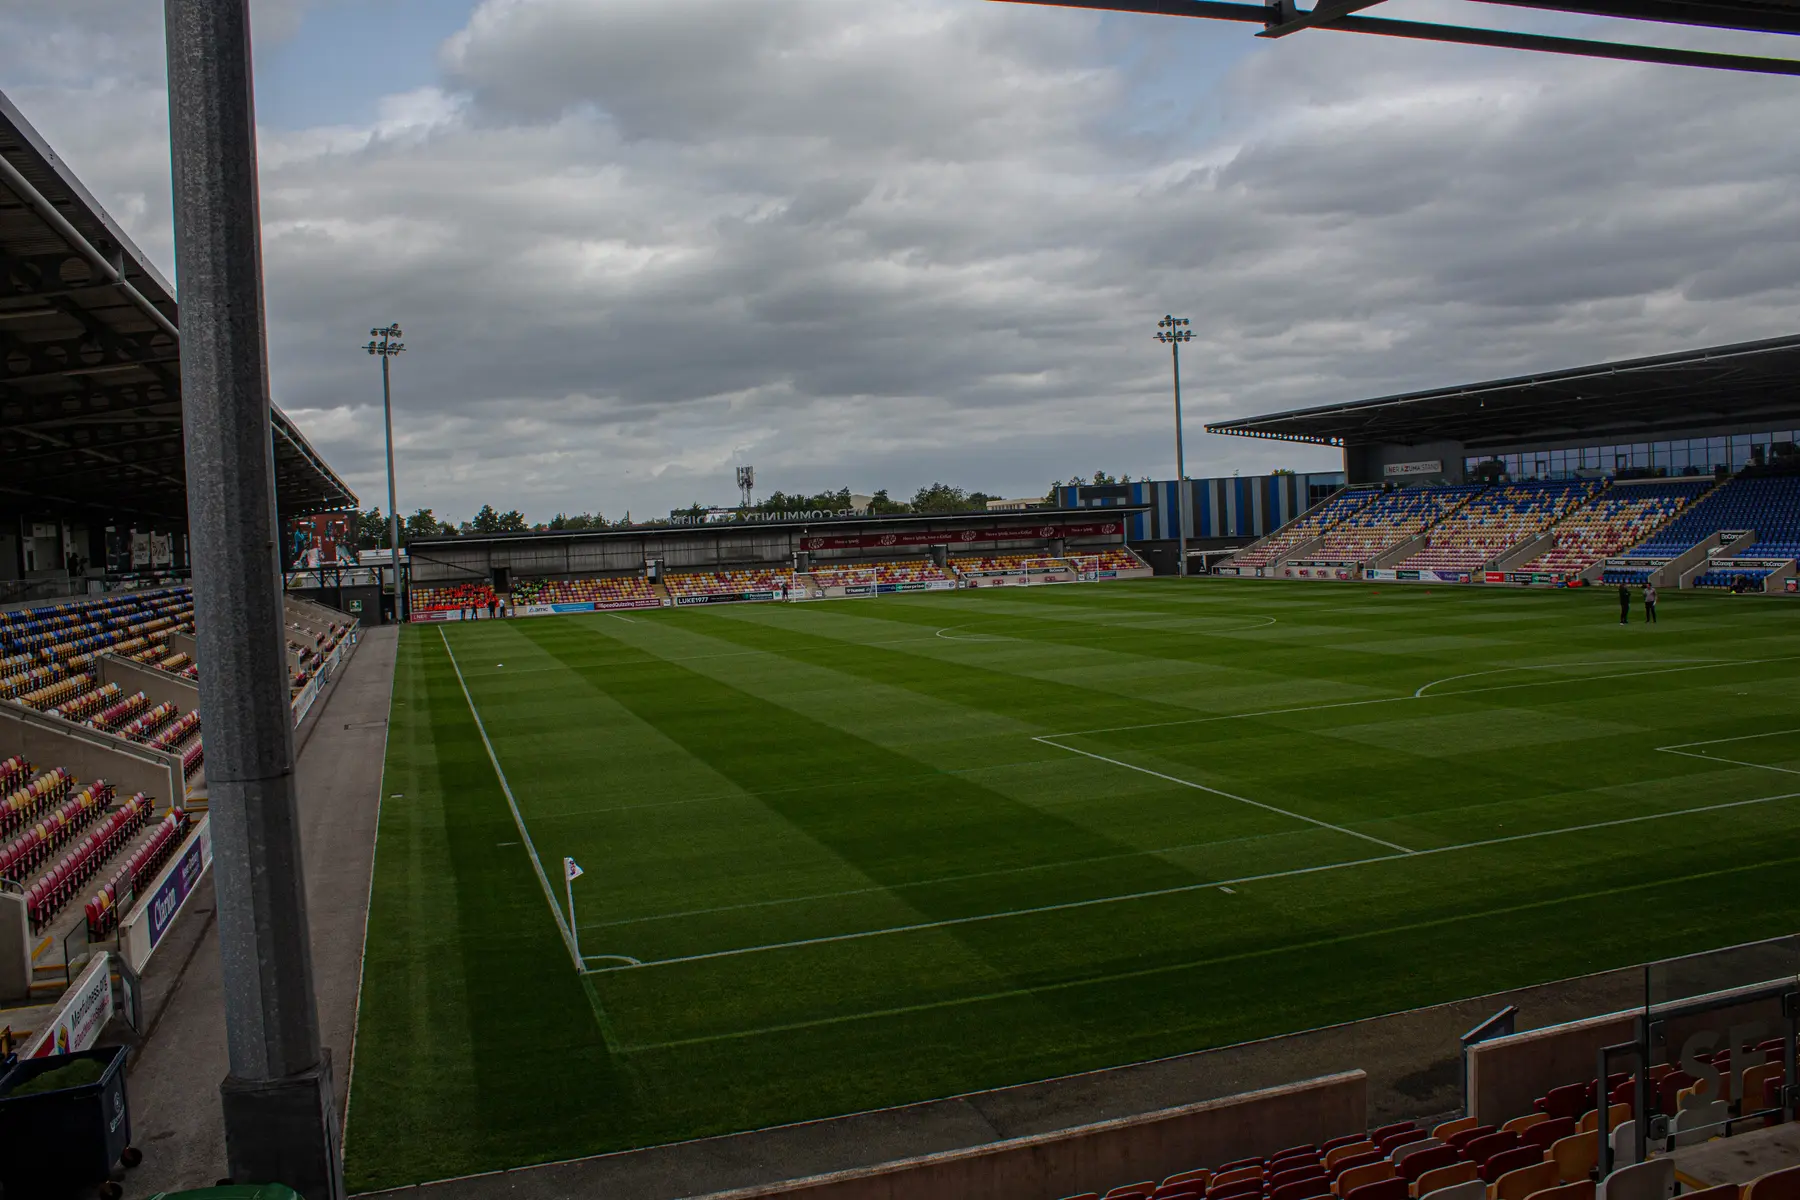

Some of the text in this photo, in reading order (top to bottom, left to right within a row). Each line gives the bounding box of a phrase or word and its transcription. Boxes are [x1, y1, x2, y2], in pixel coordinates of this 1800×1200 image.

[601, 601, 634, 609] SpeedQuizzing
[678, 597, 708, 605] LUKE1977
[154, 888, 176, 931] Clarion
[71, 972, 108, 1031] Menfulness.org
